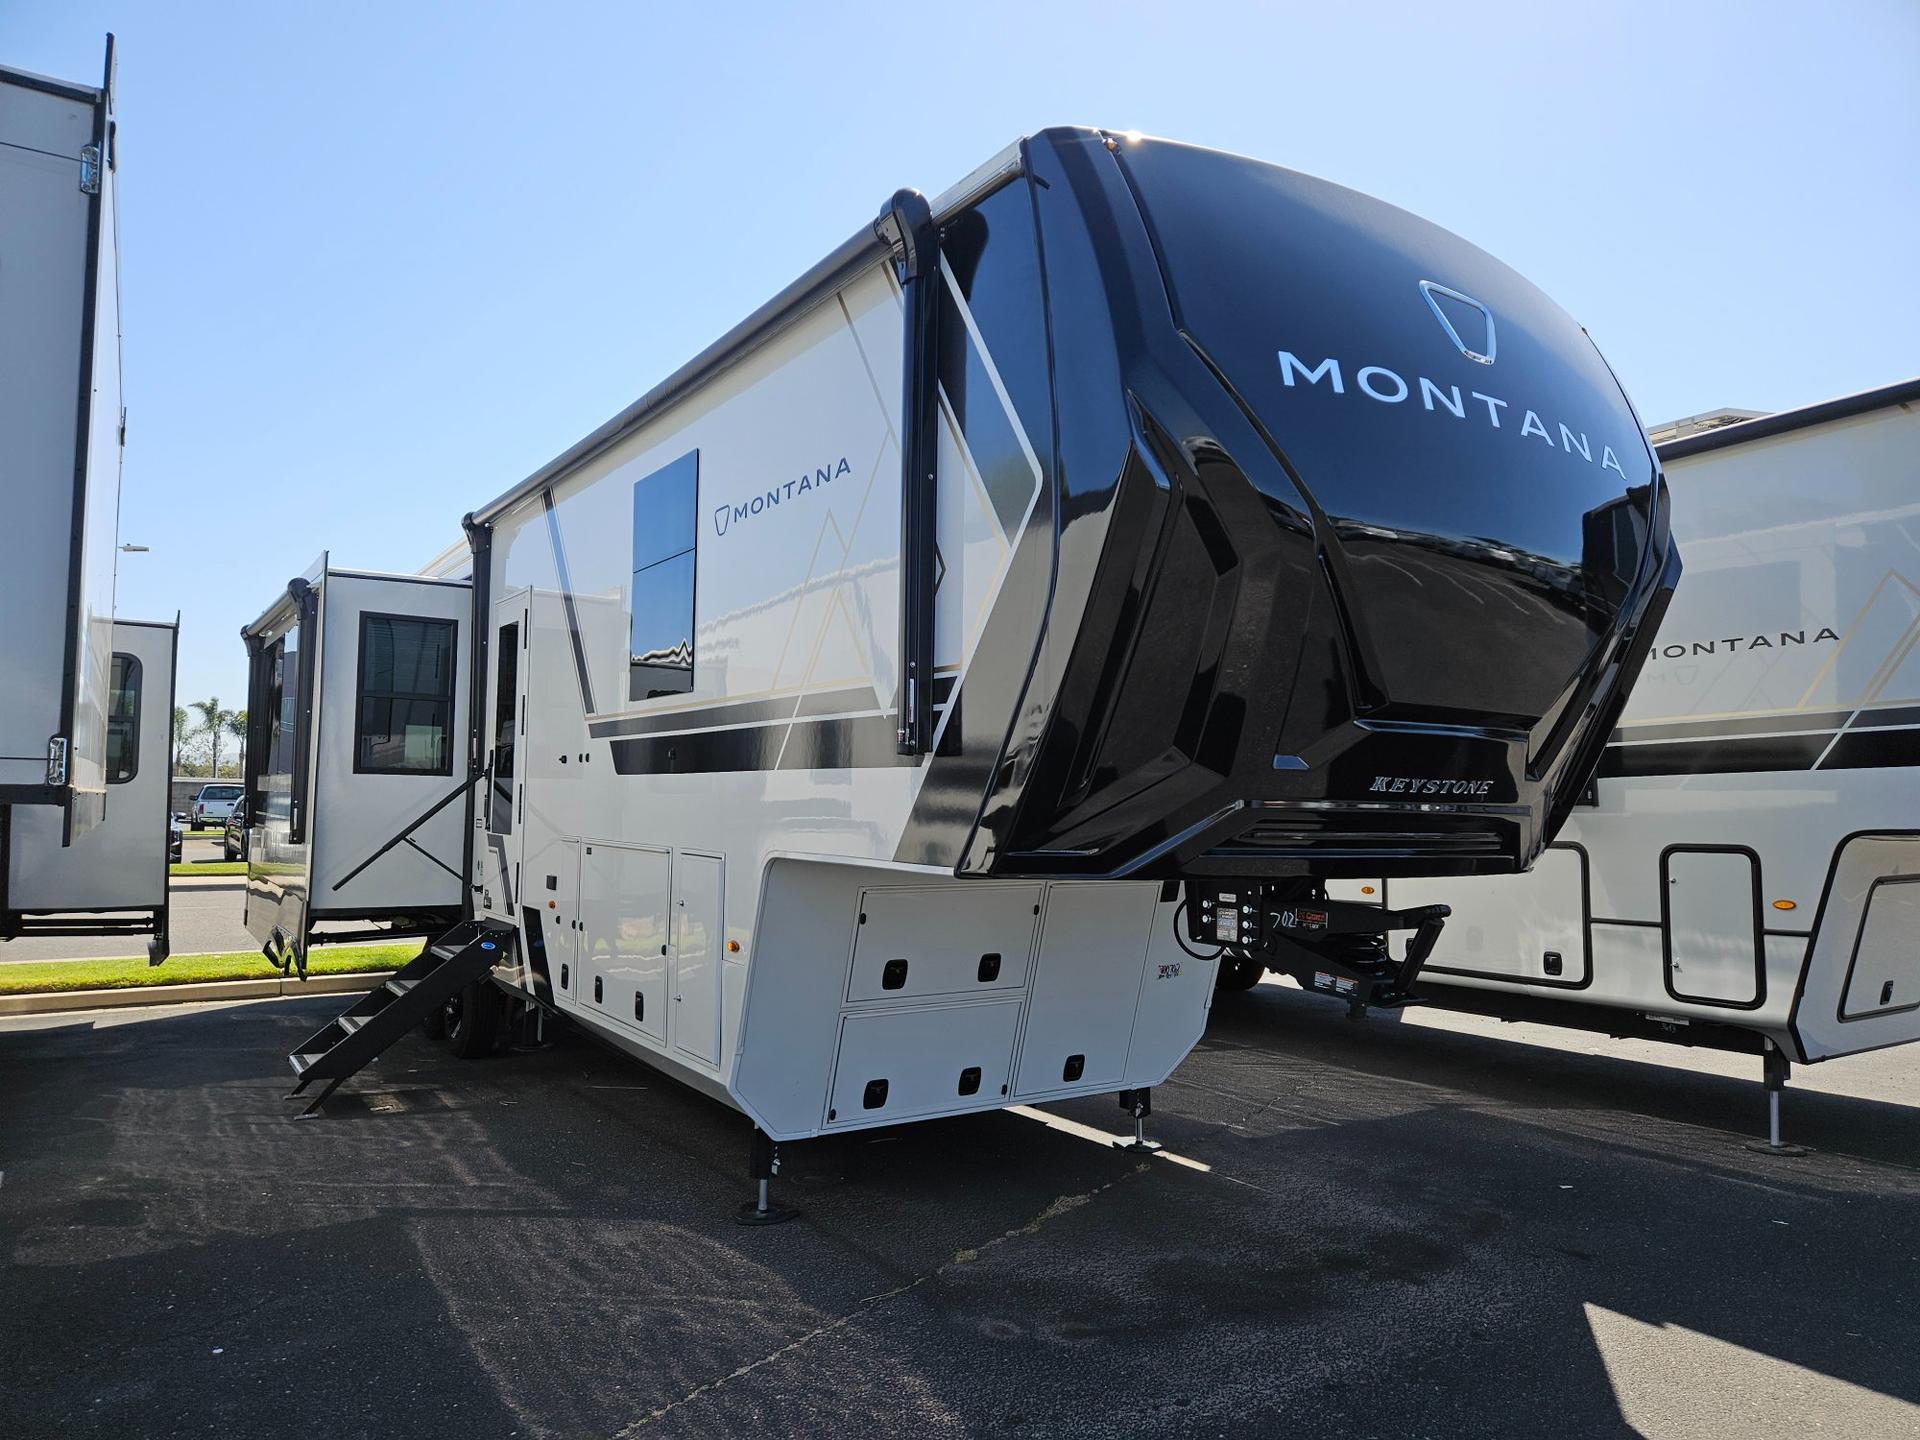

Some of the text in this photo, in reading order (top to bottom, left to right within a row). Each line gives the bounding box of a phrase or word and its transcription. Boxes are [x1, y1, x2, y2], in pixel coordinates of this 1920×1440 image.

[1278, 350, 1627, 480] MONTANA
[733, 457, 852, 523] MONTANA
[1369, 775, 1495, 795] KEYSTONE
